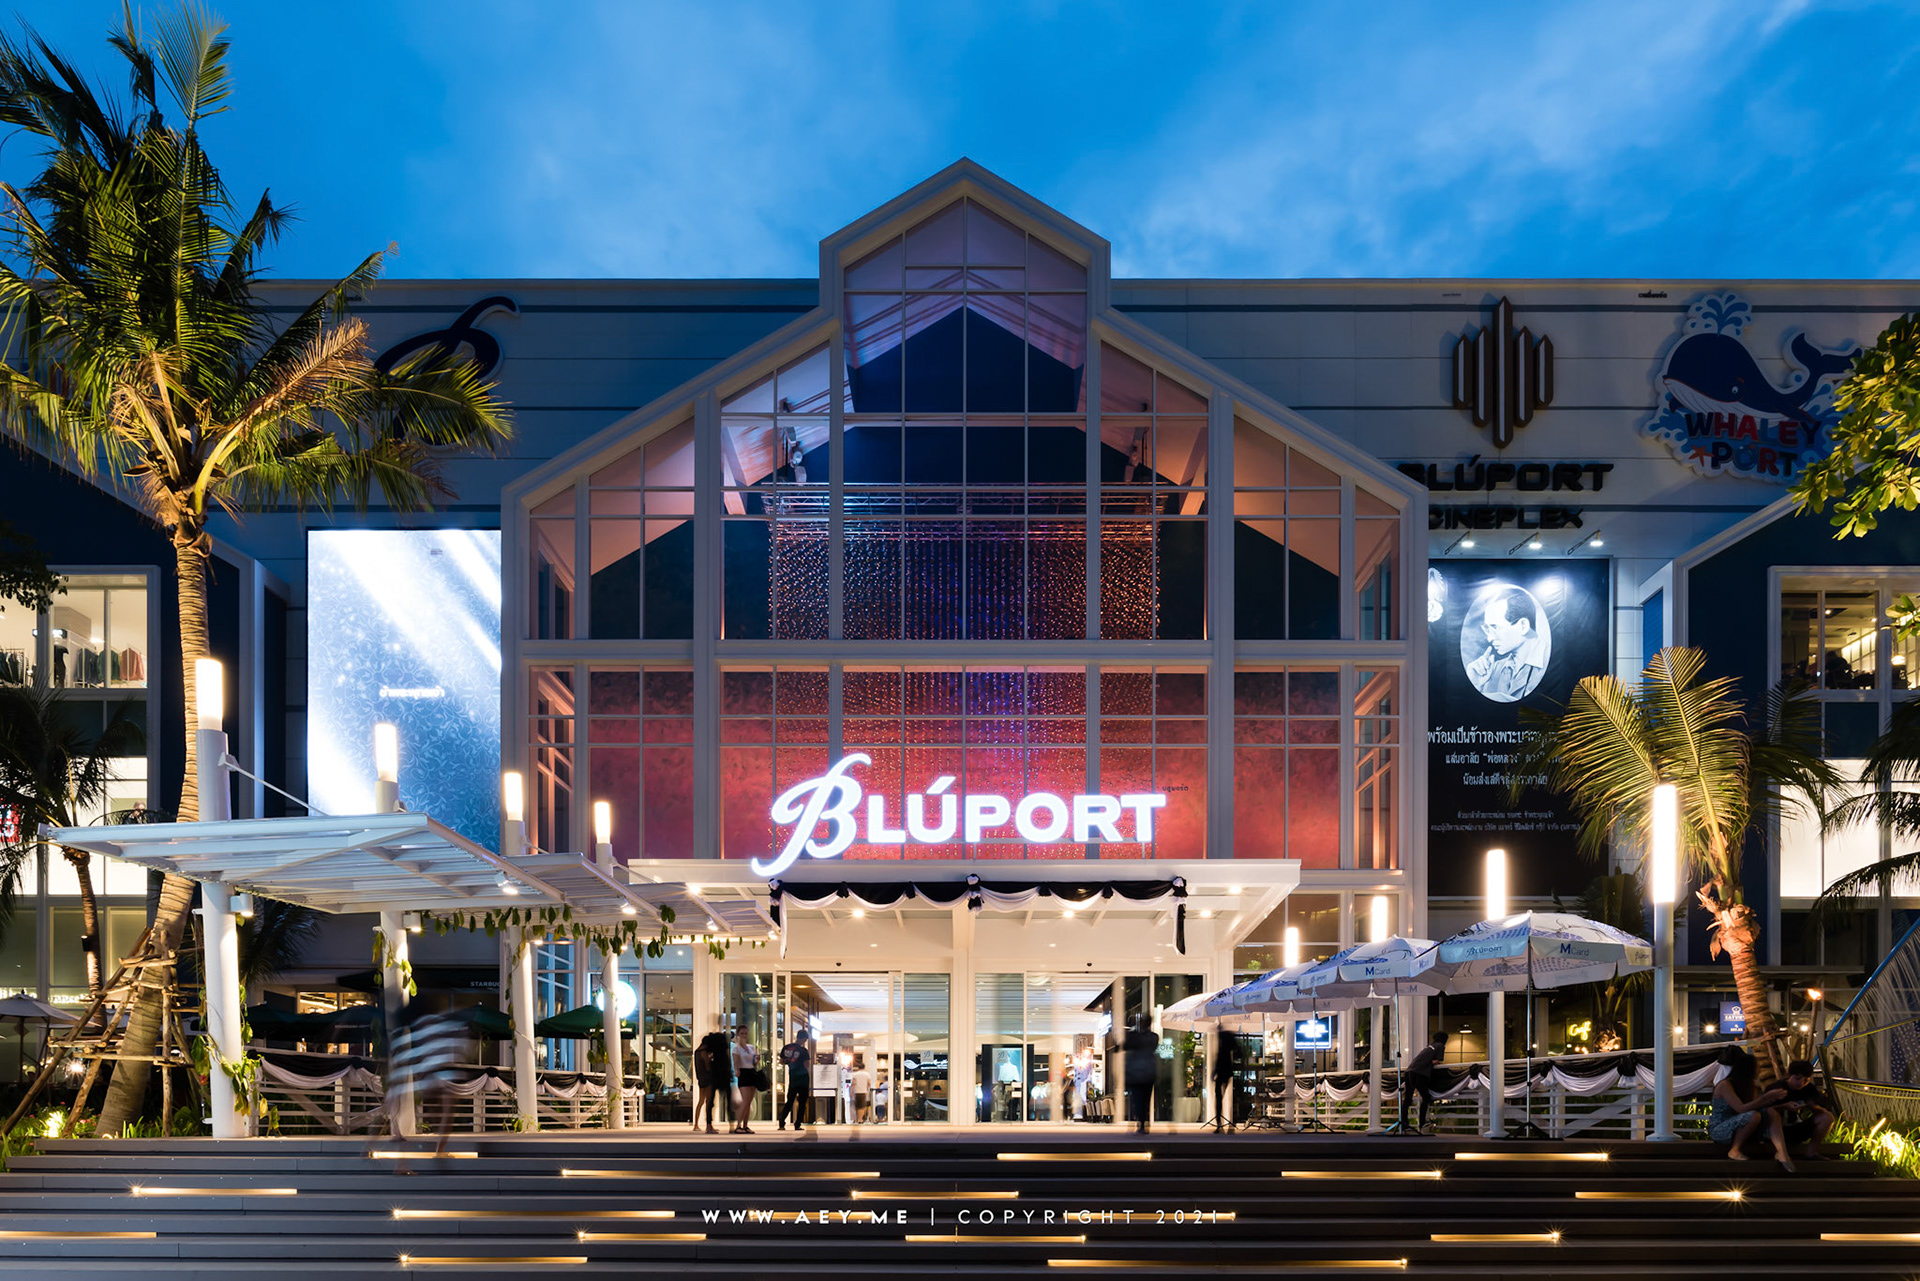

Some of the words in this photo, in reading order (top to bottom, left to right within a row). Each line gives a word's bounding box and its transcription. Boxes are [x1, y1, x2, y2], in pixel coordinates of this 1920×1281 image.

[1684, 412, 1822, 447] WHALEY
[1711, 442, 1798, 477] PORT
[751, 753, 1166, 877] BLÚPORT
